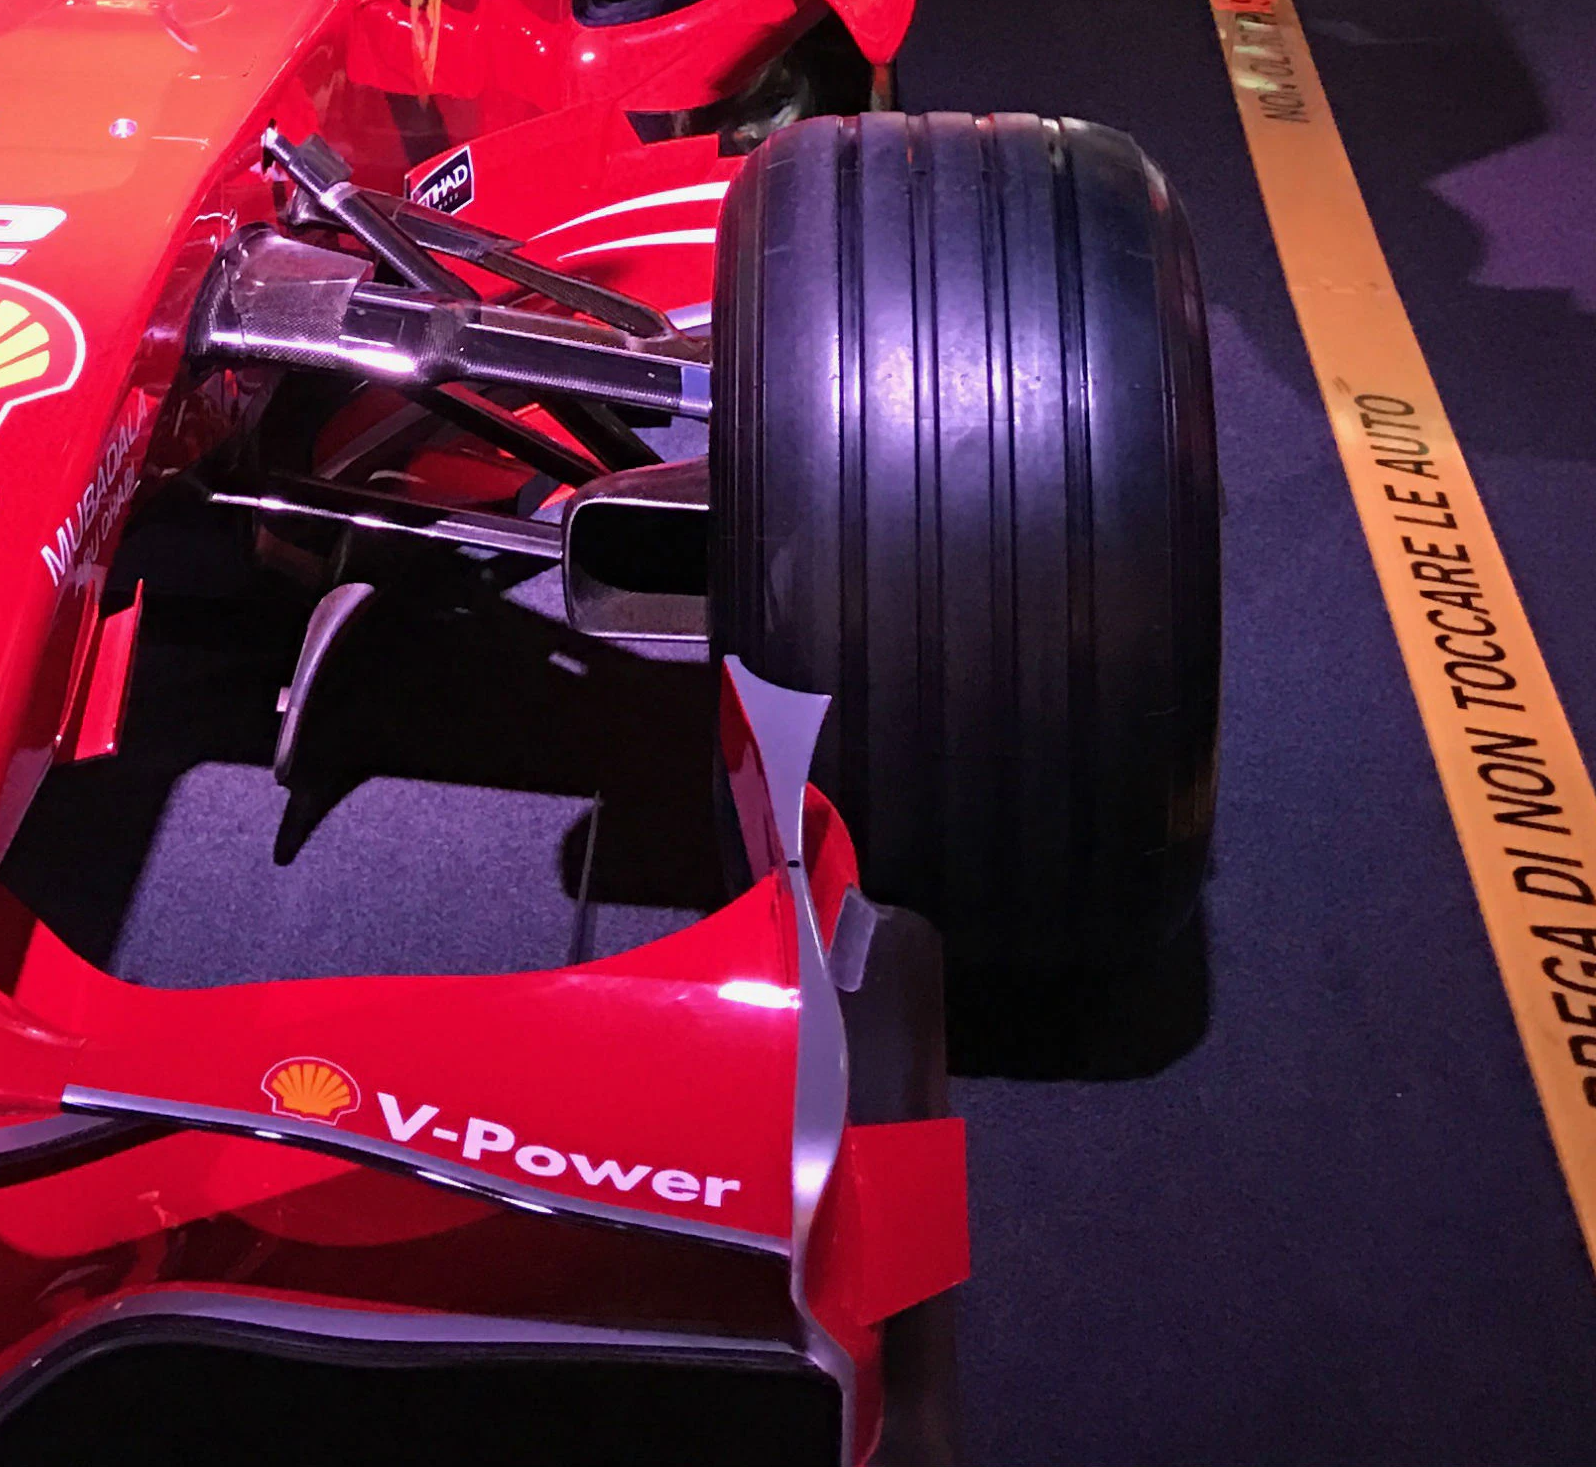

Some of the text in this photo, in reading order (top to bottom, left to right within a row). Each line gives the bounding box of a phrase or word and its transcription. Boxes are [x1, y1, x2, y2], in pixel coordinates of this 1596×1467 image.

[40, 388, 148, 588] MUBADALA
[1353, 393, 1439, 480] AUTO
[1383, 483, 1458, 530] LE
[1401, 534, 1526, 712] TOCCARE
[1464, 726, 1572, 836] NON
[1503, 846, 1596, 907] DI
[376, 1091, 741, 1208] V-Power
